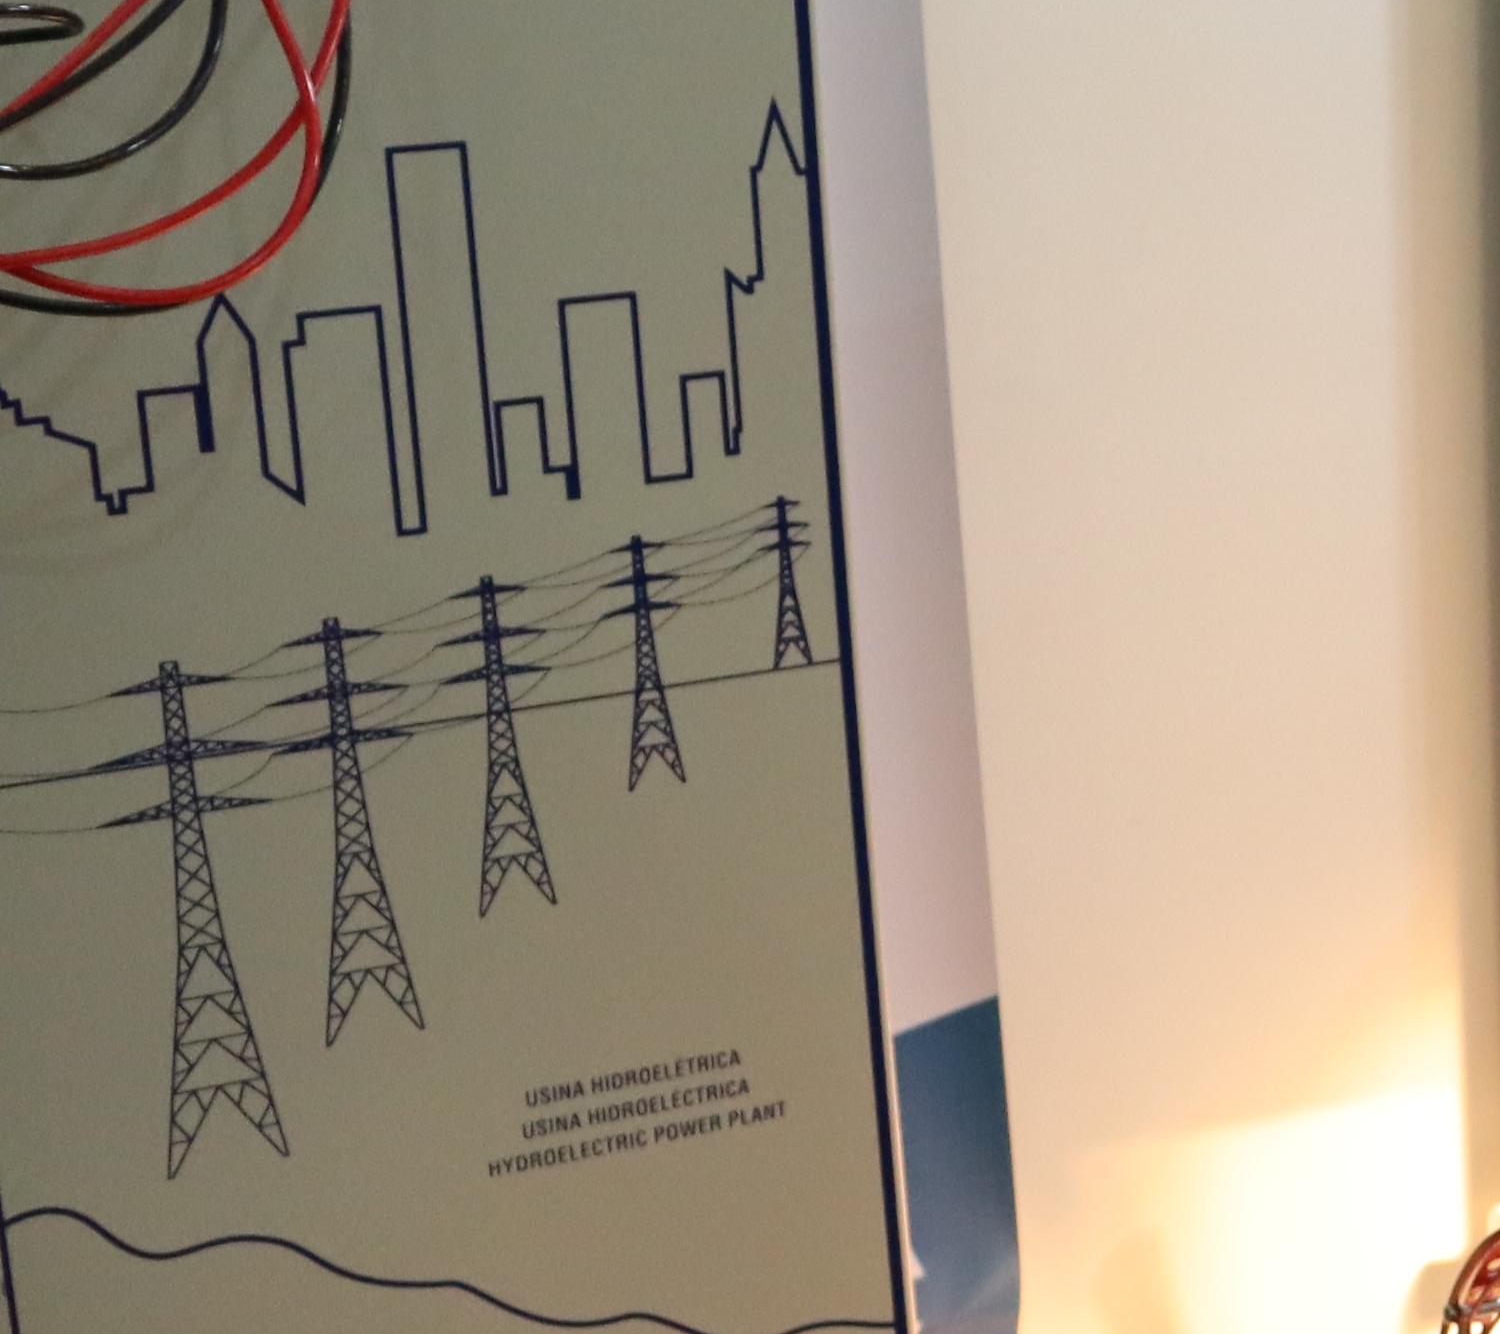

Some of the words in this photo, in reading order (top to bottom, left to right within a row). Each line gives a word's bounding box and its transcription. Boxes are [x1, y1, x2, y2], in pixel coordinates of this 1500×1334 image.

[525, 1080, 586, 1109] USINA
[487, 1129, 649, 1178] HYDROELECTRIC
[652, 1113, 723, 1144] POWER
[726, 1099, 787, 1129] PLANT
[521, 1113, 582, 1140] USINA
